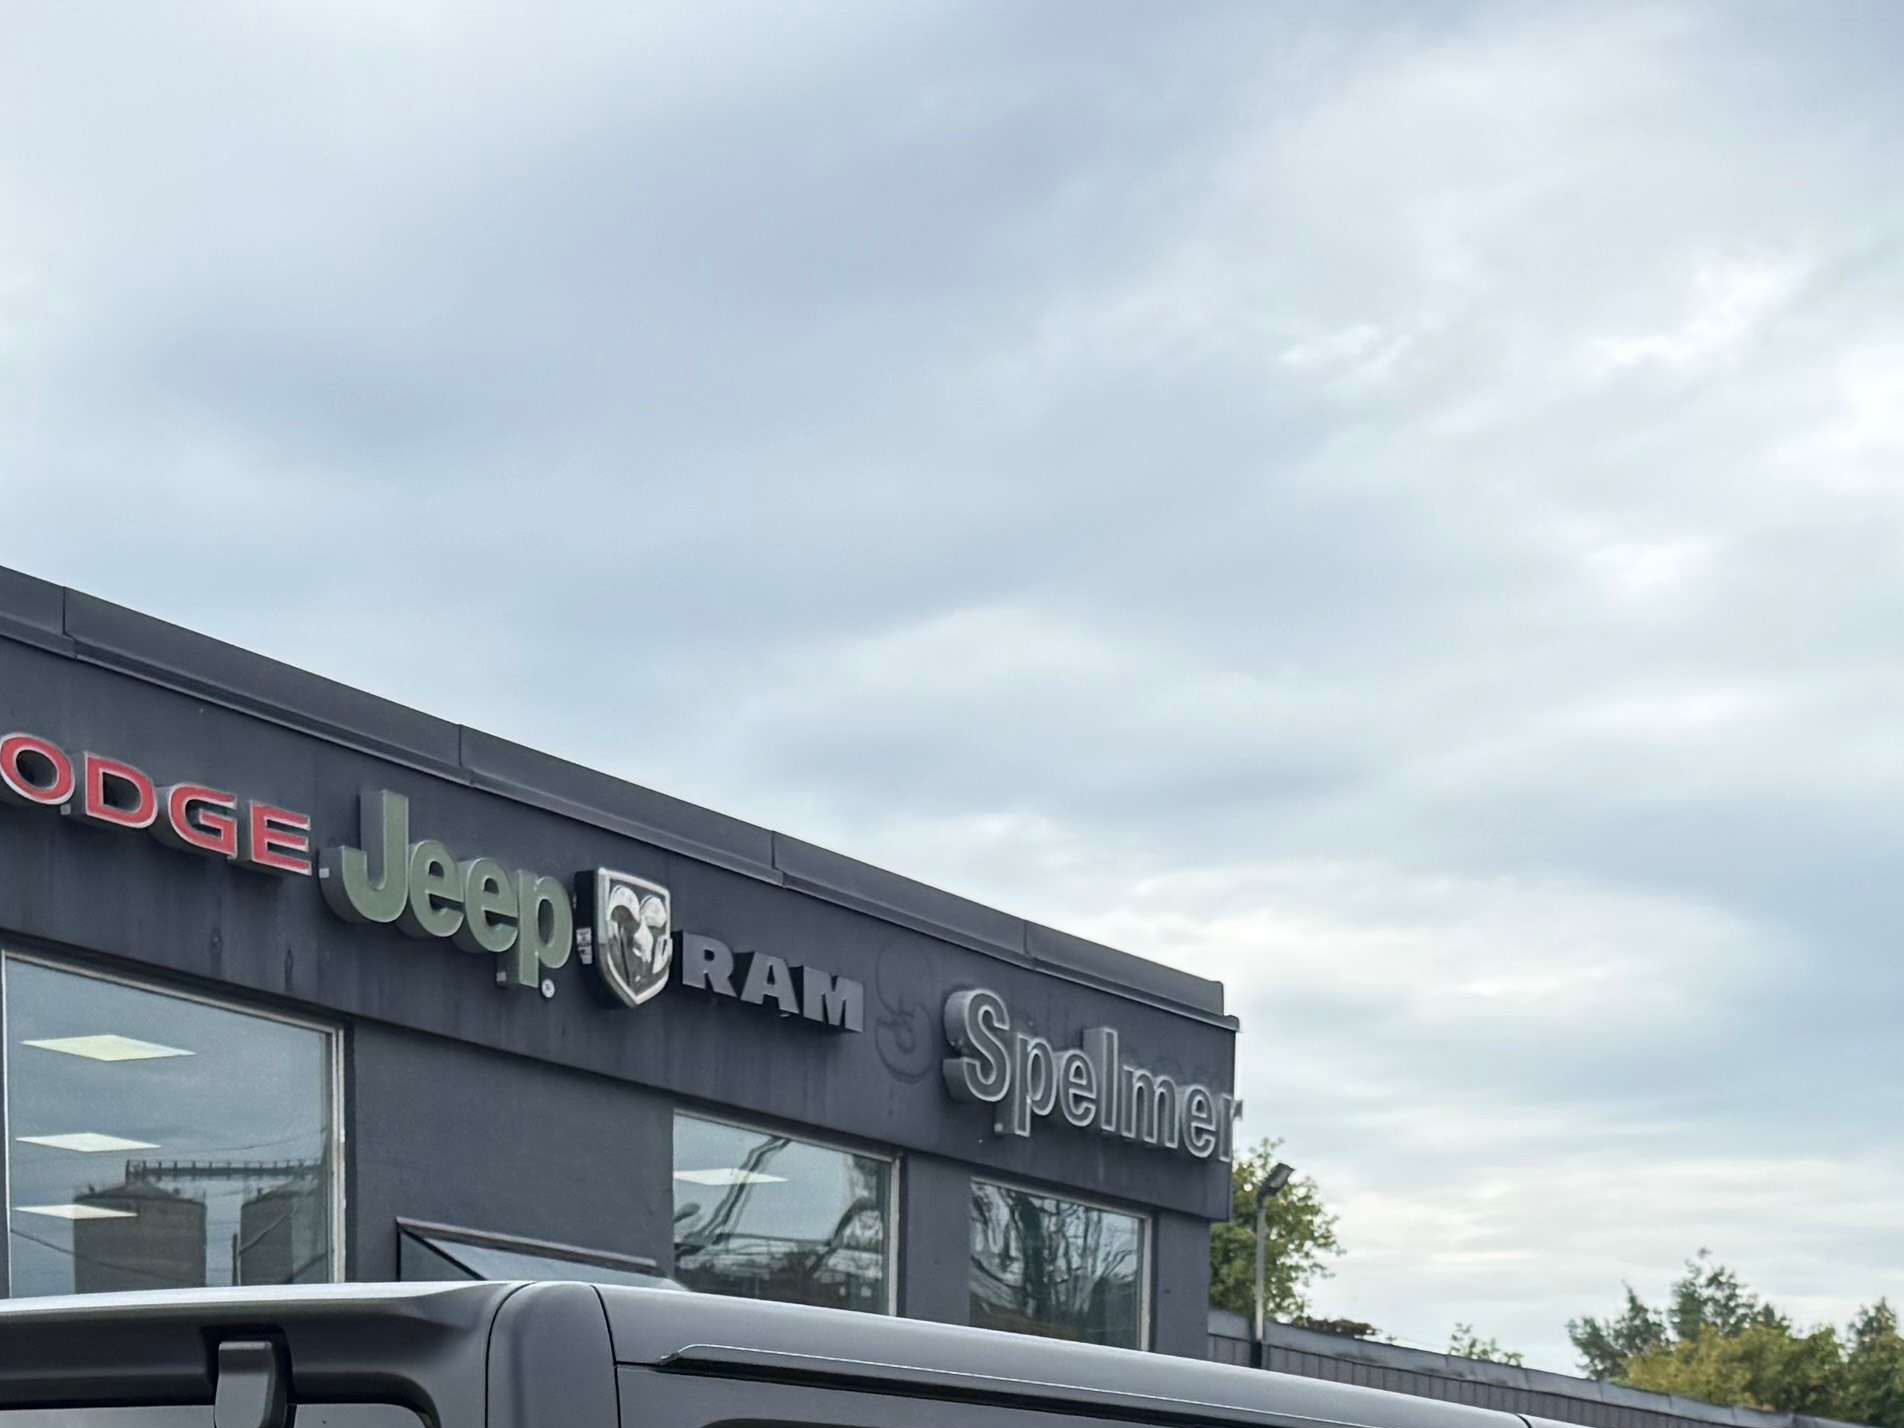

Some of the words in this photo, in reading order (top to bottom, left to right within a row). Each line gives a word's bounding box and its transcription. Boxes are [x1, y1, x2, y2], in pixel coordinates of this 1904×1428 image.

[321, 788, 575, 989] Jeep
[681, 931, 865, 1033] RAM
[946, 986, 1245, 1162] Spelmer
